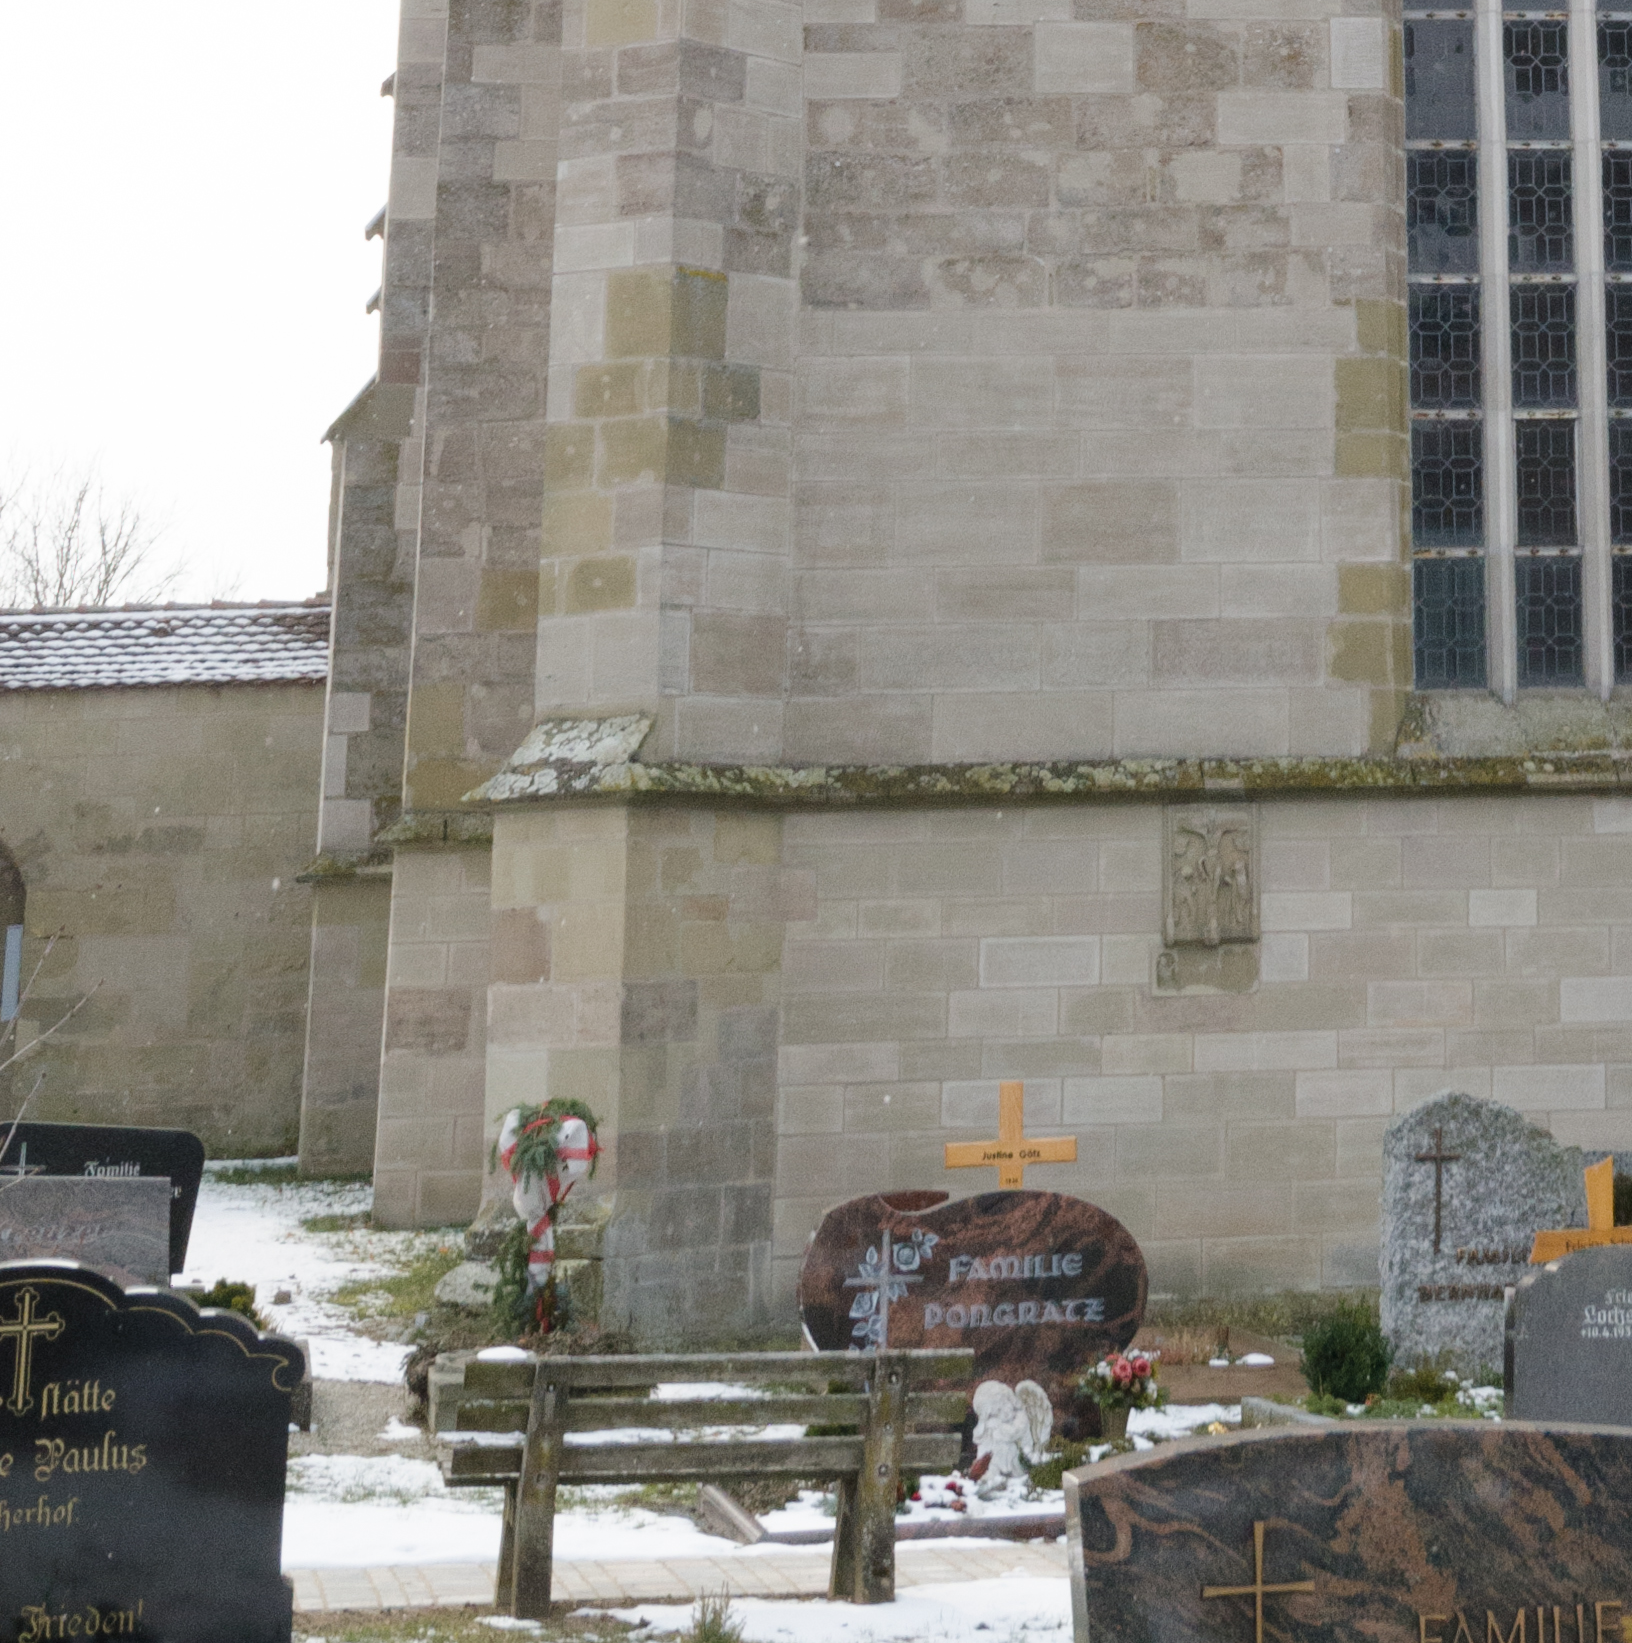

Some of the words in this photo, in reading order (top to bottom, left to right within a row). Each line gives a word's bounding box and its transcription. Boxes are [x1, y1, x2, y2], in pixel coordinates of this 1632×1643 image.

[949, 1252, 1083, 1282] FAMILIE
[924, 1297, 1105, 1330] PONGRATZ
[34, 1430, 148, 1482] Paulus
